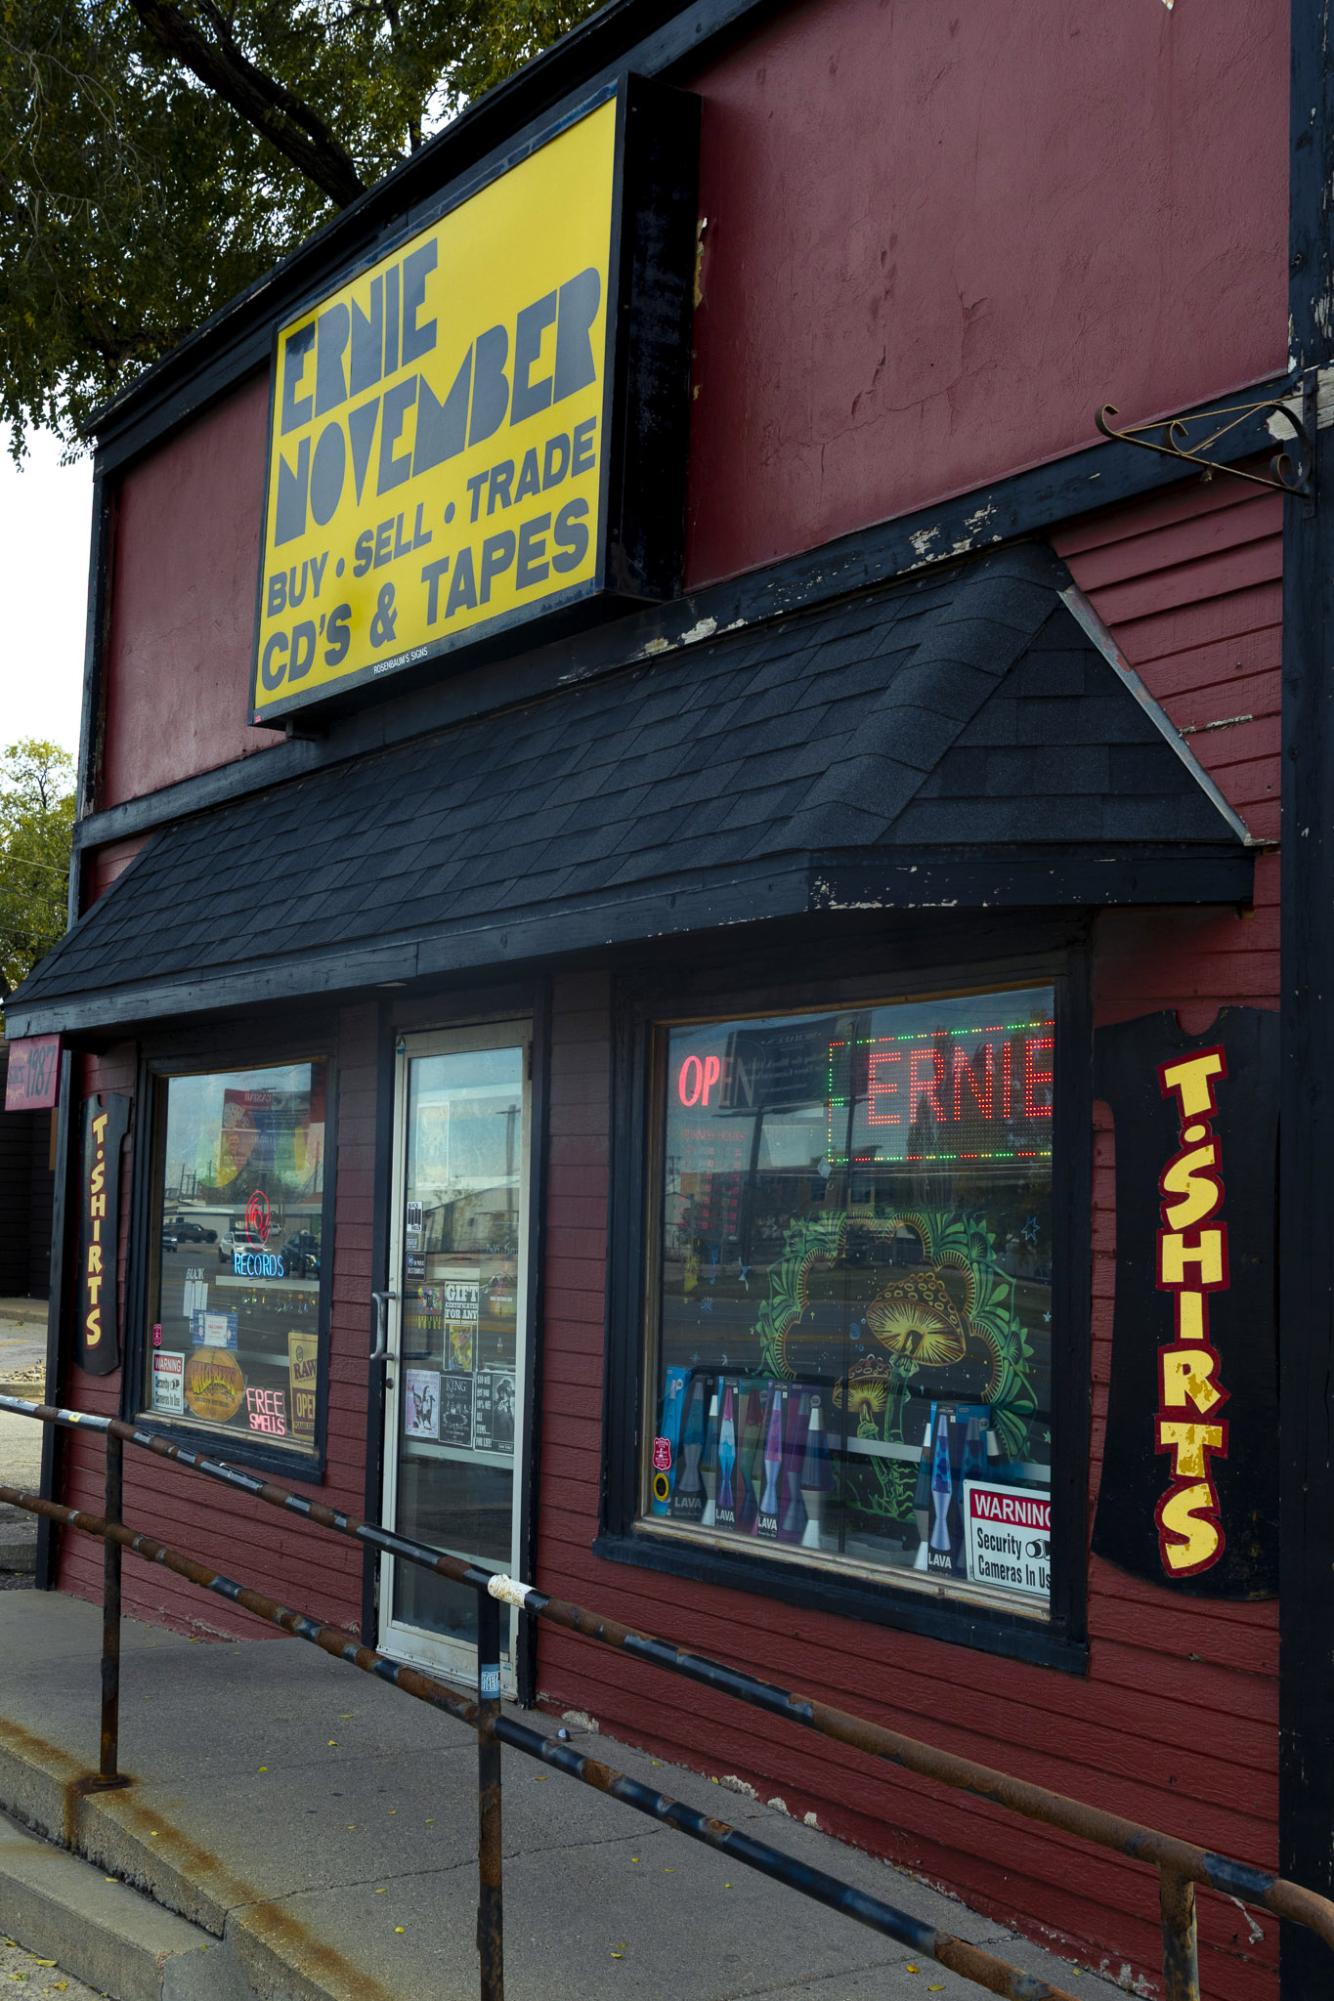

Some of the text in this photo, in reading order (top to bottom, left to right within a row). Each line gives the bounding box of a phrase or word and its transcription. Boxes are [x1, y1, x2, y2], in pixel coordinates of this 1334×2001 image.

[281, 237, 438, 436] ERNIE
[274, 266, 601, 547] NOVEMBER
[267, 416, 597, 618] BUY SELL TRADE
[261, 497, 590, 691] CD'S & TAPES
[373, 647, 428, 675] ROSENBAUM'S SIGNS
[26, 1045, 56, 1099] 1987
[867, 1037, 1055, 1126] ERNIE
[234, 1253, 285, 1278] RECORDS
[446, 1284, 478, 1302] GIFT
[446, 1308, 478, 1320] FOR ANY
[155, 1356, 182, 1373] WARNING
[293, 1358, 317, 1380] RAW
[446, 1380, 467, 1393] KING
[246, 1387, 285, 1417] FREE
[674, 1496, 702, 1510] LAVA
[715, 1508, 735, 1523] LAVA
[758, 1515, 778, 1532] LAVA
[976, 1527, 1022, 1561] Security
[928, 1553, 952, 1569] LAVA
[978, 1554, 1051, 1589] Cameras In Us
